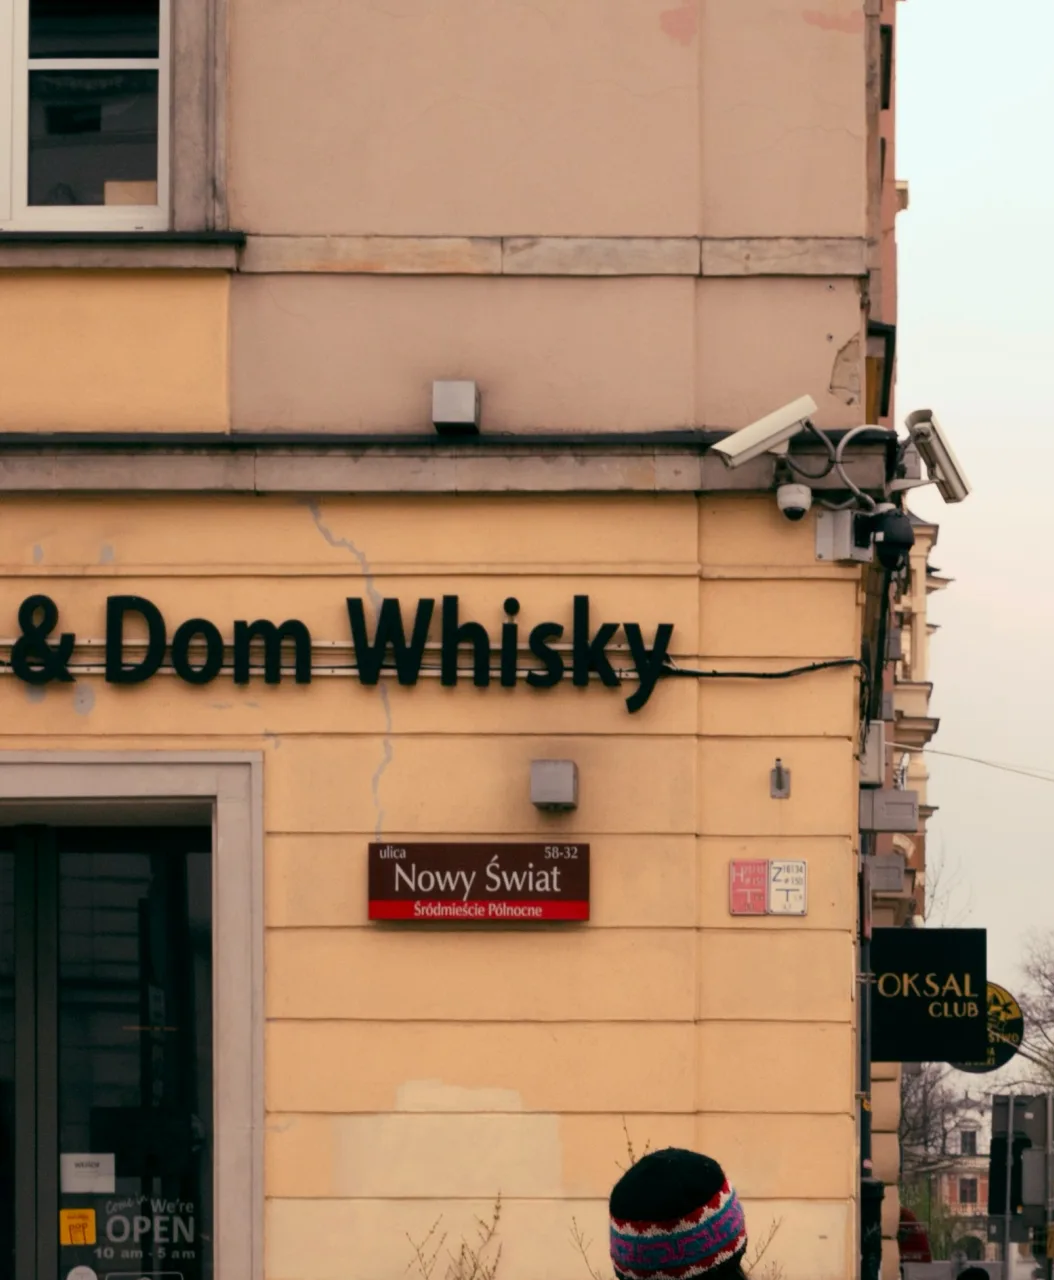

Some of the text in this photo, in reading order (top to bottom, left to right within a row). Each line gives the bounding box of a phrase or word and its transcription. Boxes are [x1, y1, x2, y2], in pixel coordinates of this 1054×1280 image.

[11, 594, 674, 714] & Dom Whisky
[379, 846, 407, 859] ulica
[544, 846, 579, 859] 58-32
[394, 854, 561, 901] Nowy Świat
[732, 866, 744, 883] H
[772, 866, 783, 882] Z
[414, 900, 543, 917] Śródmieście Północne
[928, 1001, 979, 1018] CLUB
[105, 1198, 133, 1214] Come
[150, 1199, 194, 1213] We're
[106, 1214, 195, 1244] OPEN
[93, 1246, 115, 1259] 10
[121, 1249, 143, 1259] am
[157, 1246, 166, 1259] 5
[171, 1249, 196, 1259] am
